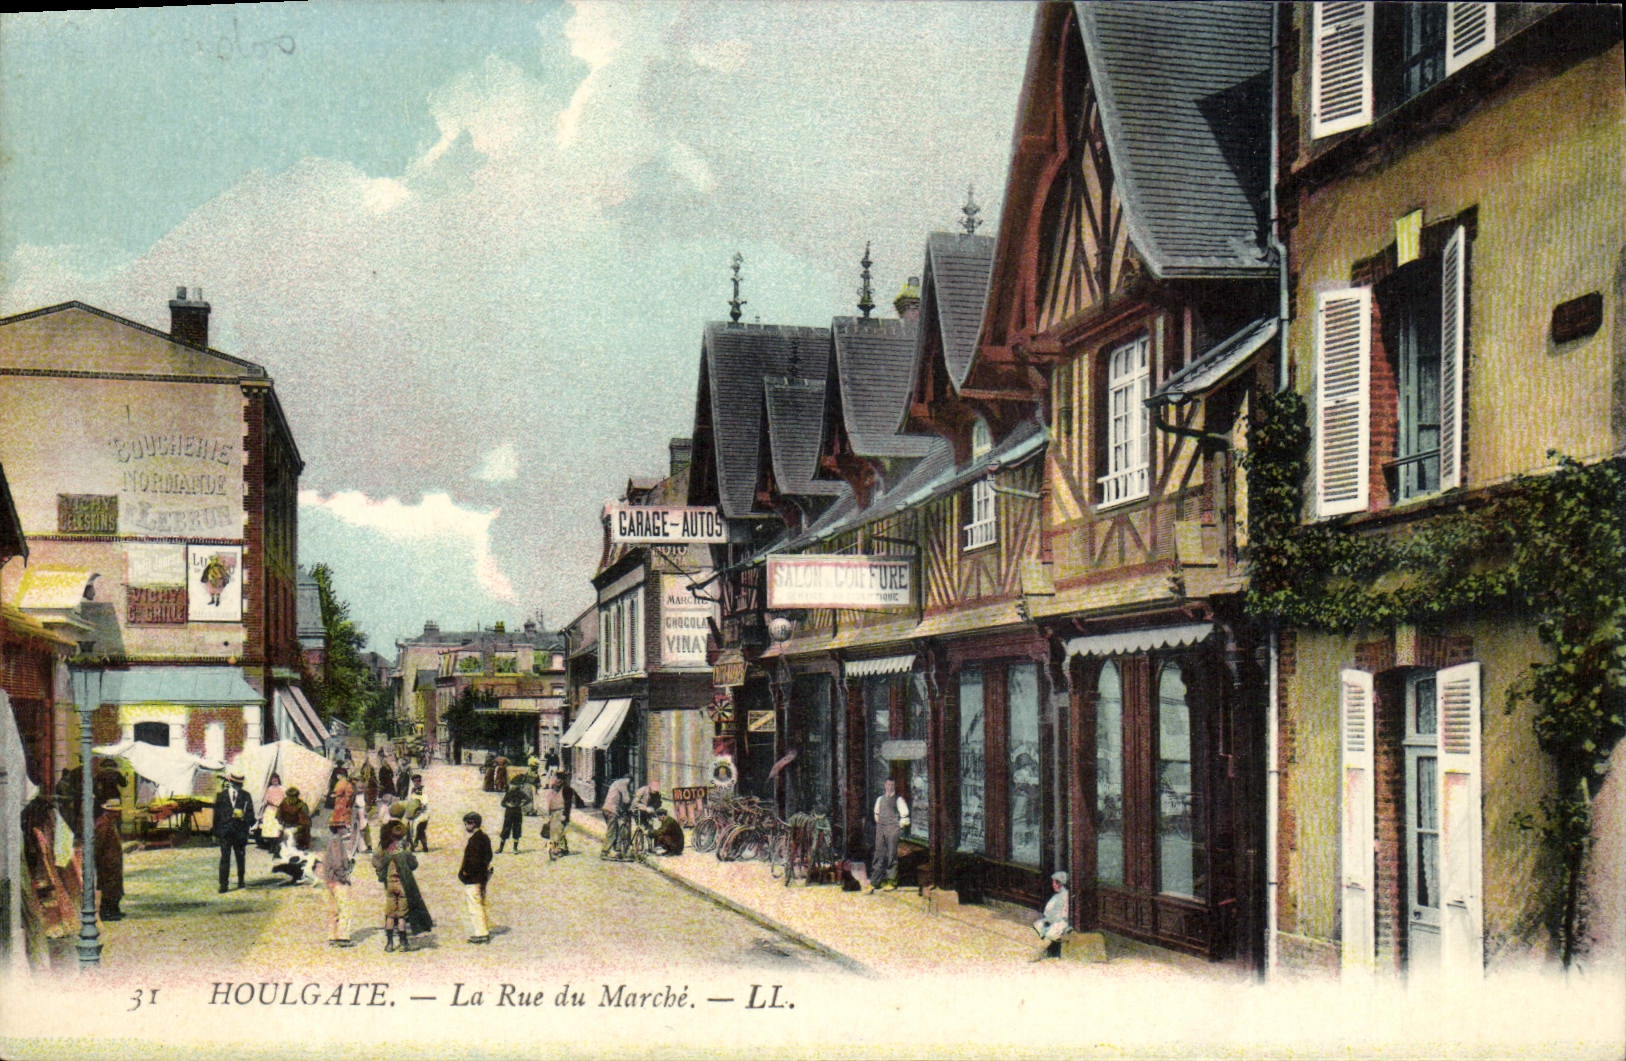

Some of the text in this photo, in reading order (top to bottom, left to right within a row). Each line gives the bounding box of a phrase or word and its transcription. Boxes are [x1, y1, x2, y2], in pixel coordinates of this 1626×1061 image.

[121, 470, 228, 496] NORMANDE
[774, 564, 908, 590] SALON COIFFURE
